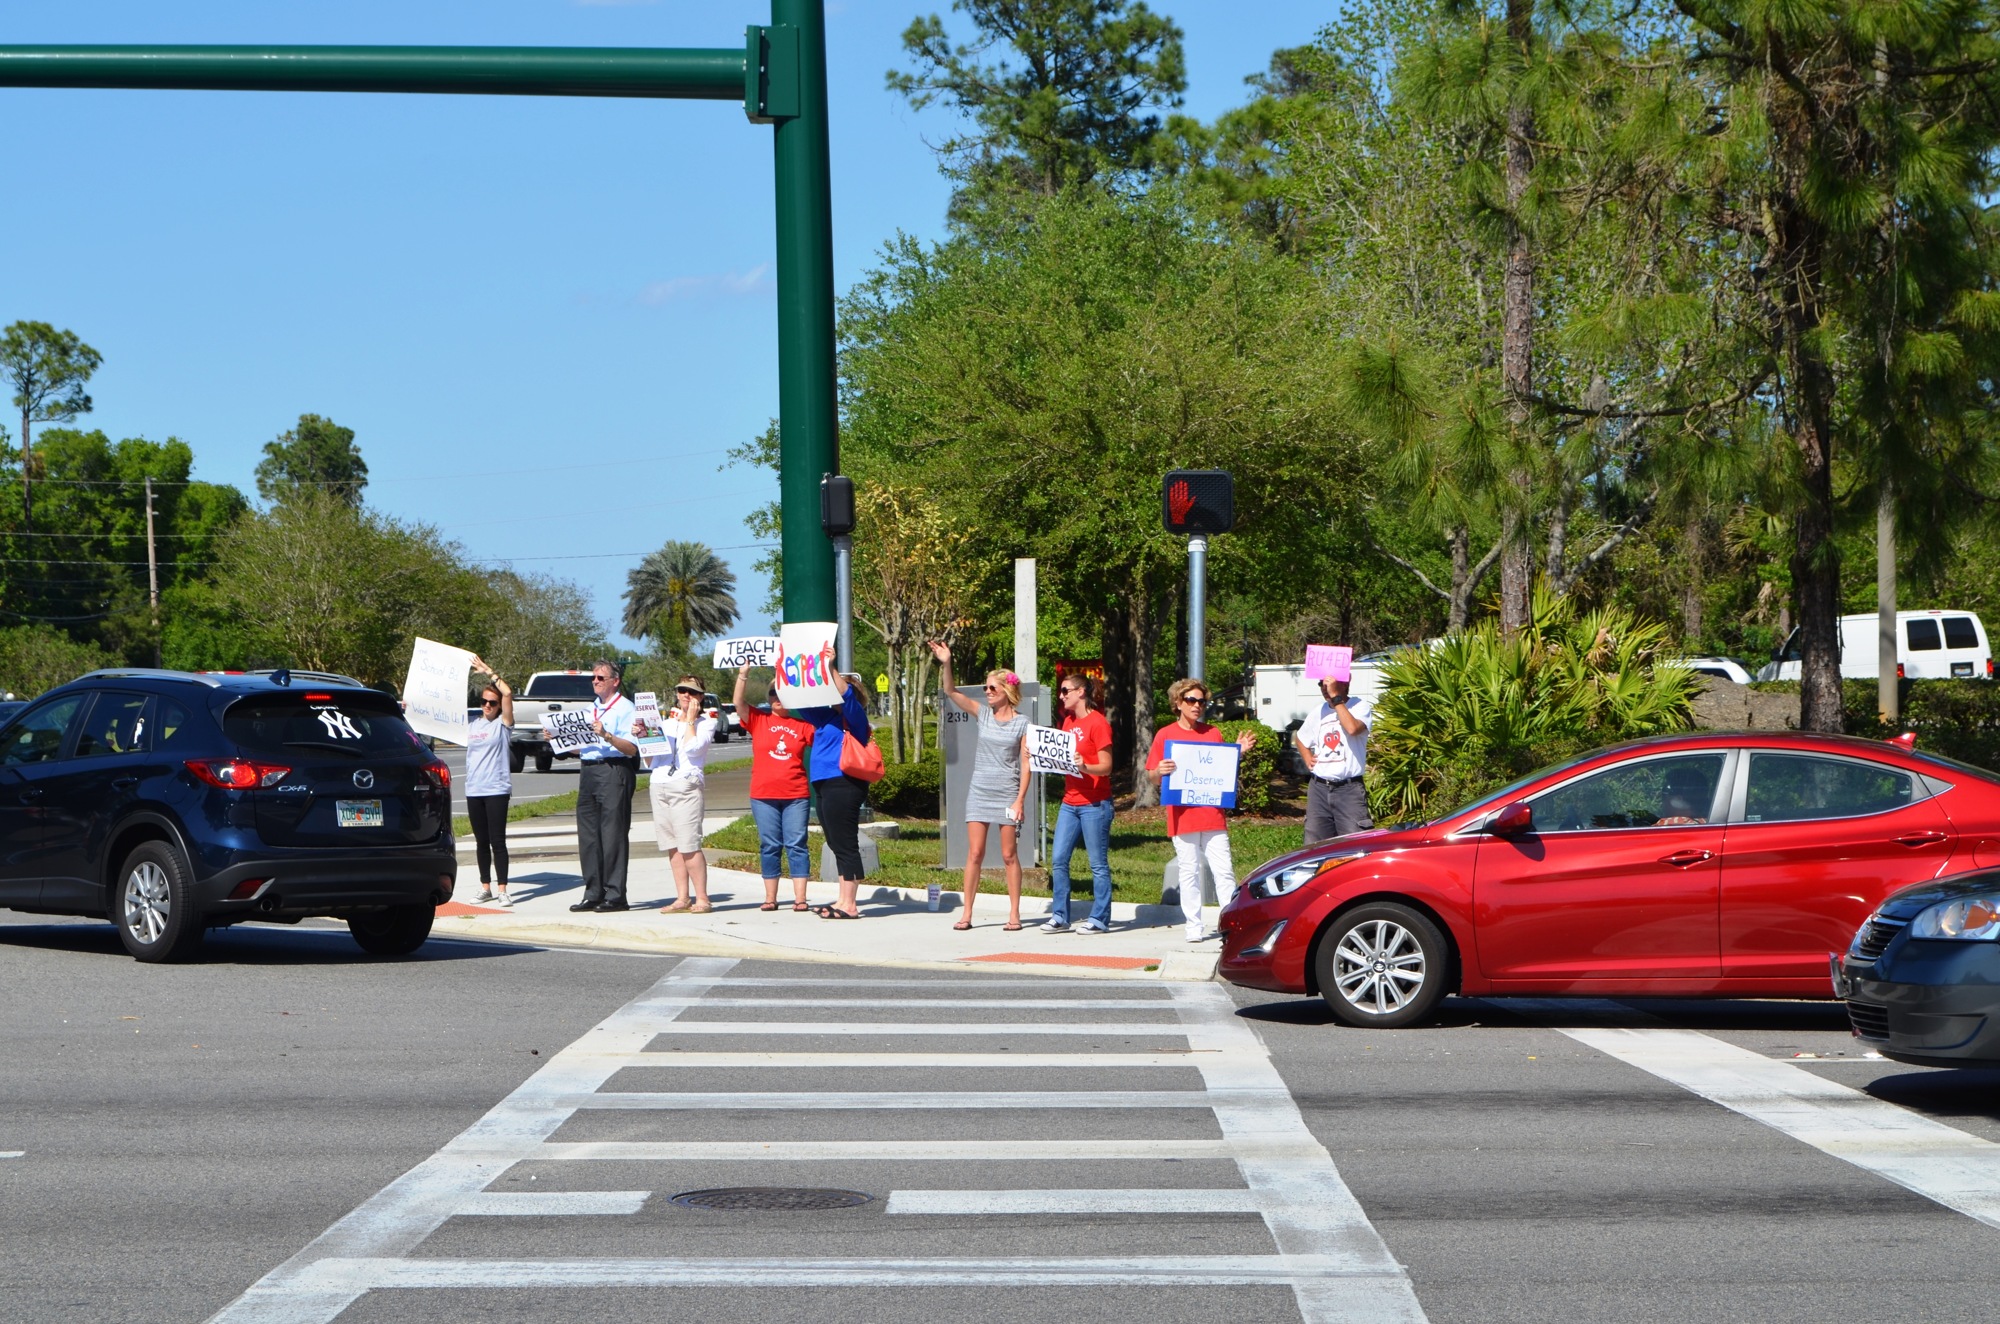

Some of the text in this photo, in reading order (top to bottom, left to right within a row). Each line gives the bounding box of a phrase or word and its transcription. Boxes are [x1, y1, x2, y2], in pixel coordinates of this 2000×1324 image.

[727, 640, 775, 655] TEACH
[420, 658, 447, 677] School
[719, 654, 768, 668] MORE
[776, 640, 829, 690] Respect
[420, 681, 453, 702] Needs To
[412, 702, 430, 716] Work
[432, 706, 450, 721] With
[547, 710, 588, 728] TEACH
[947, 711, 969, 723] 239
[317, 710, 362, 739] NY
[558, 723, 595, 735] MORE
[552, 733, 582, 749] TEST
[1035, 729, 1070, 749] TEACH
[1037, 744, 1072, 763] MORE
[1198, 750, 1214, 765] We
[1184, 768, 1225, 786] Deserve
[1186, 789, 1221, 805] Better
